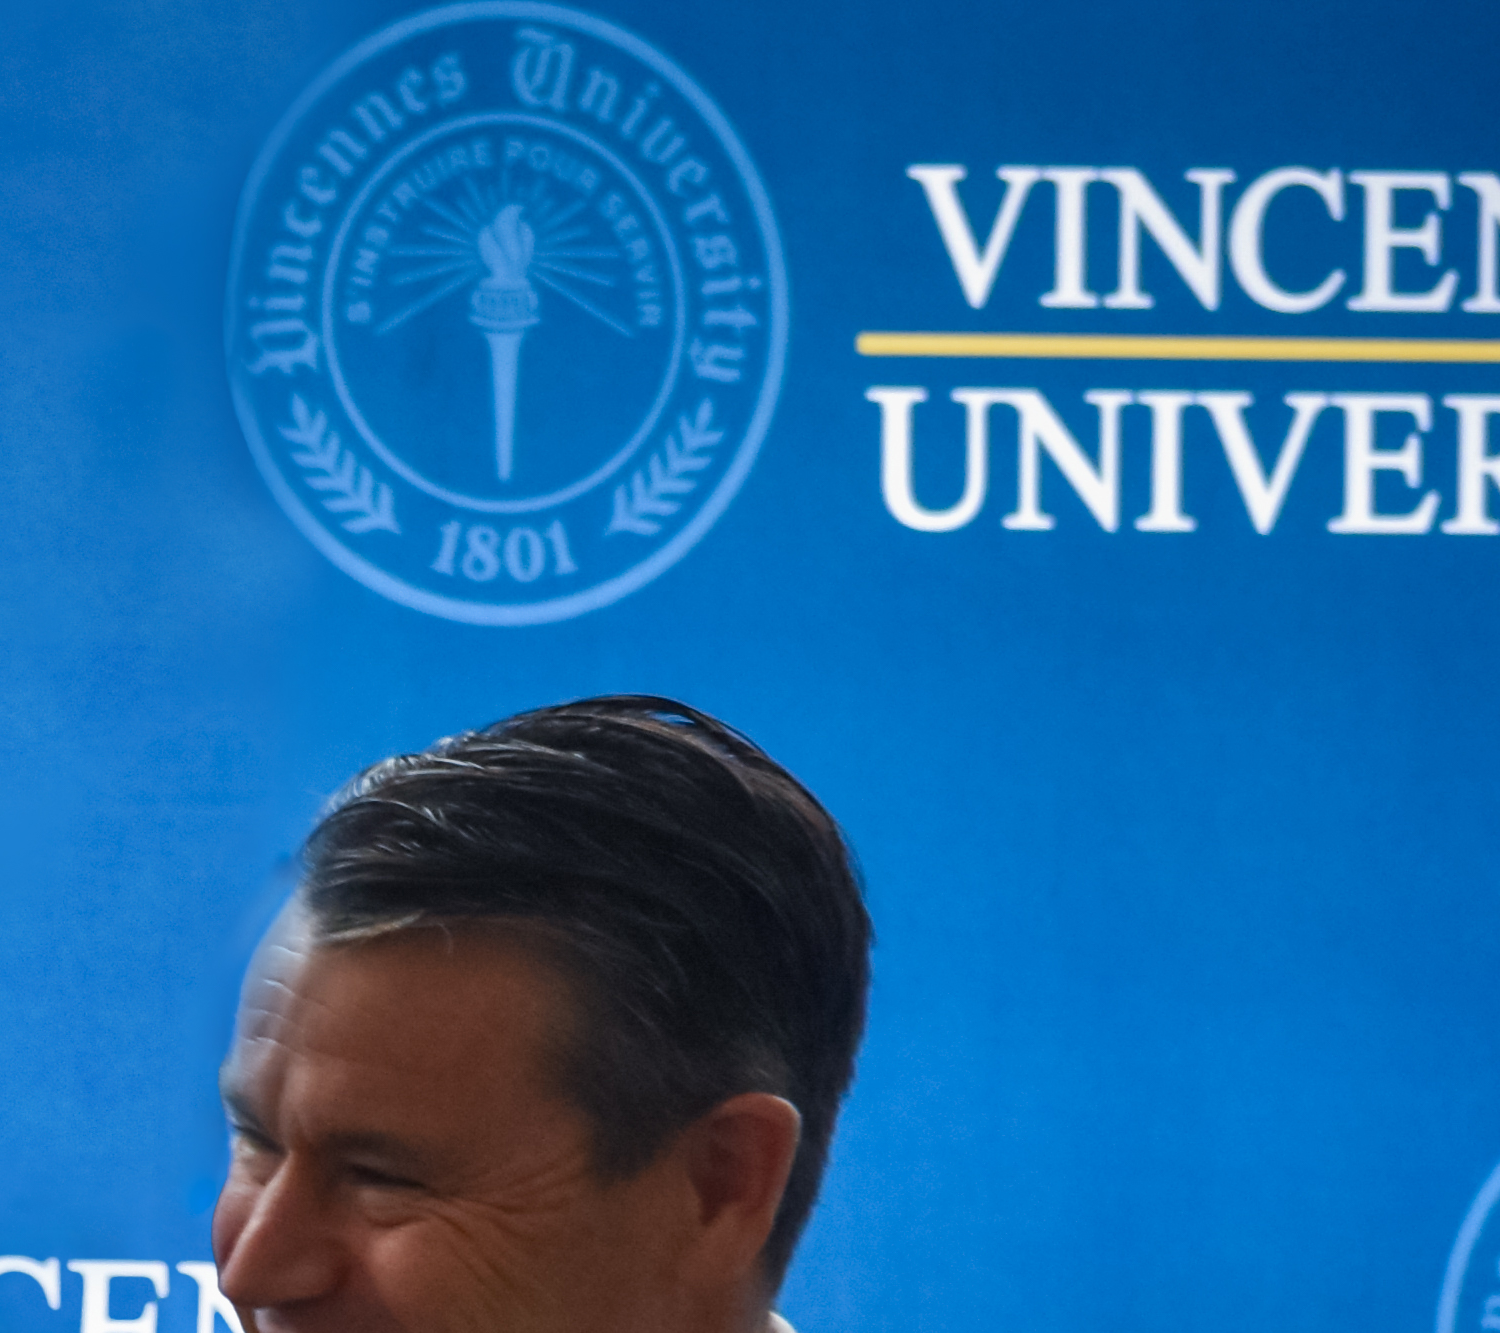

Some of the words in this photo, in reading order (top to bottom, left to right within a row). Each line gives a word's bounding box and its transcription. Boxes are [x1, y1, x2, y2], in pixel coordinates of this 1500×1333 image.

[243, 51, 468, 375] Vincennes
[510, 26, 765, 384] University
[906, 163, 1500, 314] VINCE
[430, 518, 579, 583] 1801
